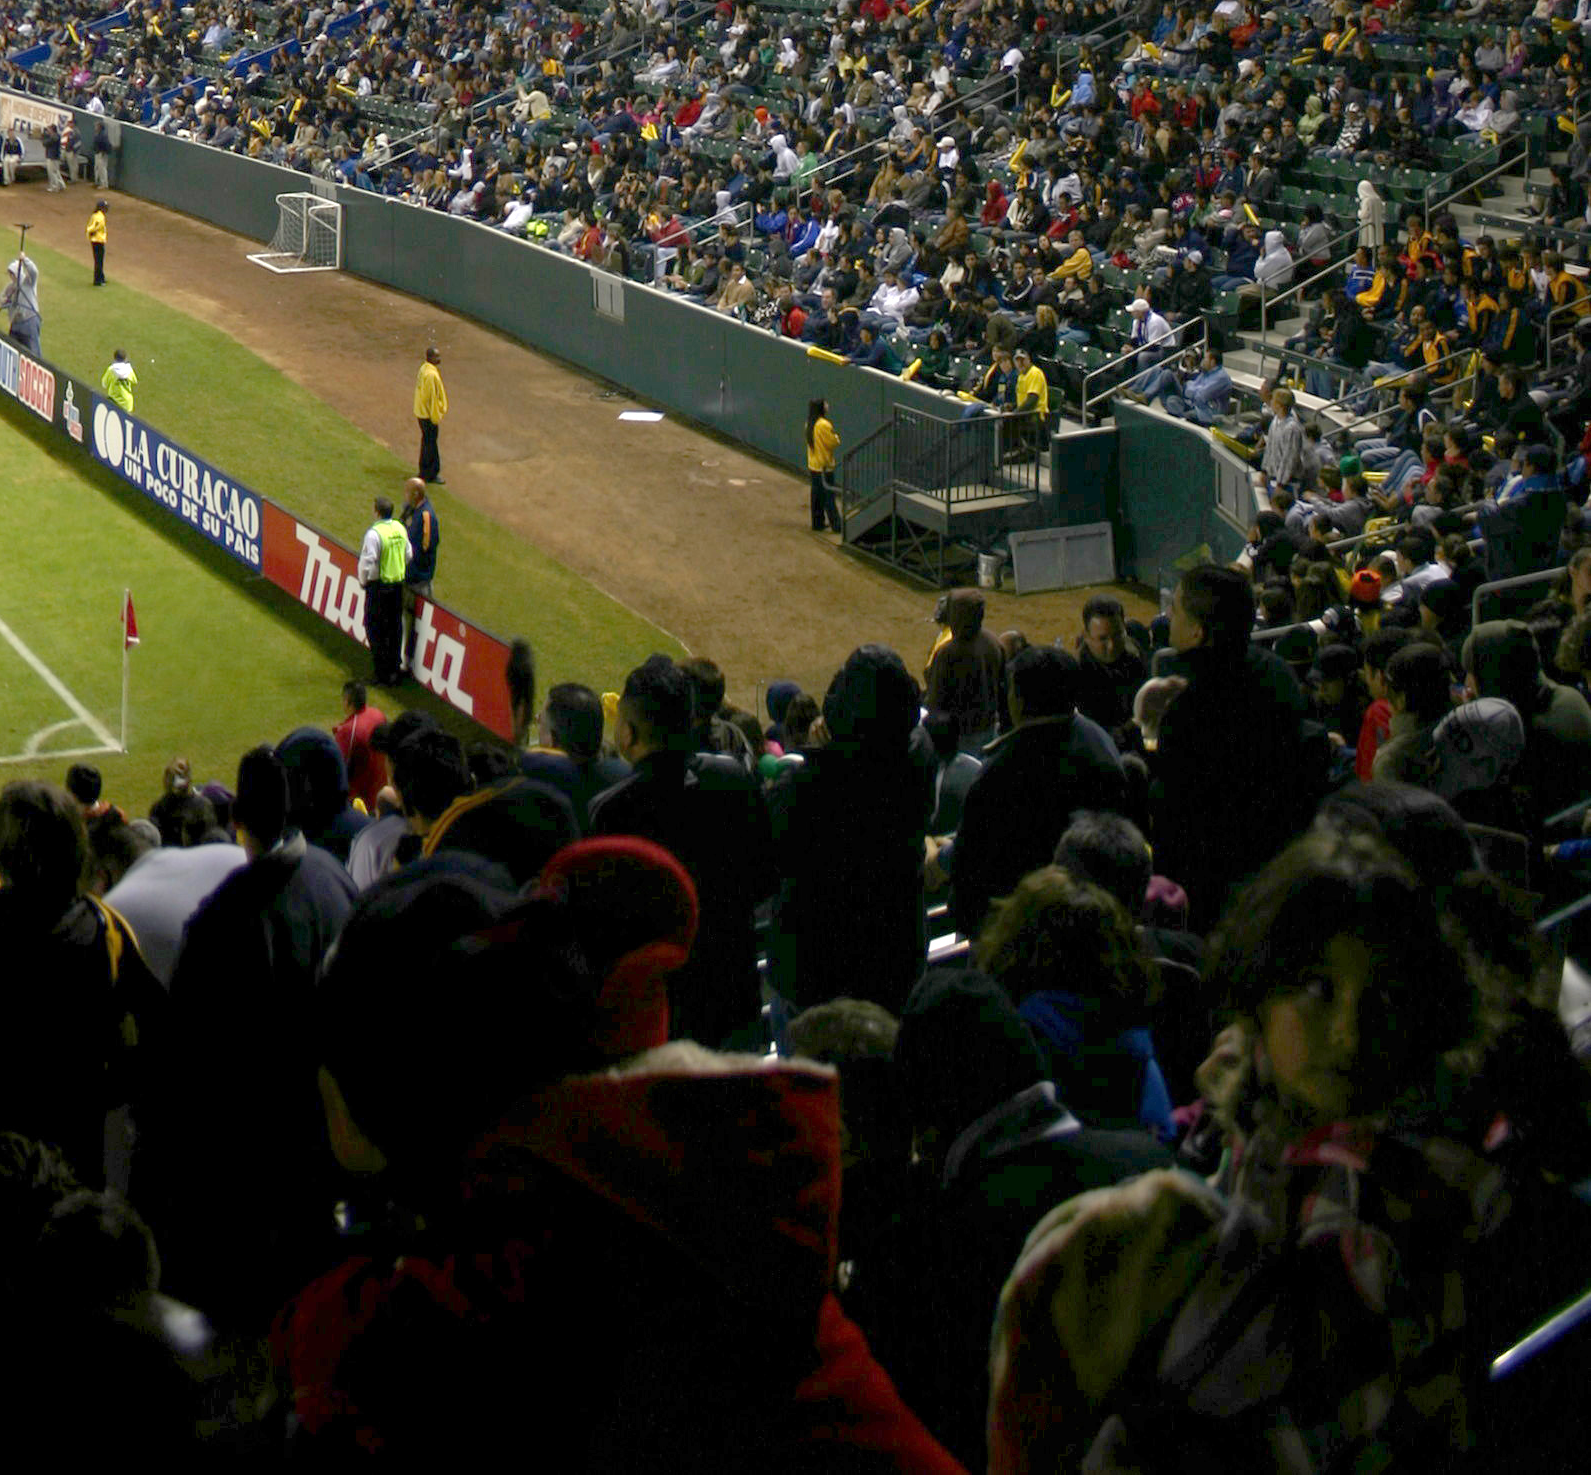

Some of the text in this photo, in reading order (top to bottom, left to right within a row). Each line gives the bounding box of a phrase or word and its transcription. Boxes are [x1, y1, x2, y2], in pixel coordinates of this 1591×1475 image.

[18, 353, 56, 423] SOCCER
[124, 456, 260, 566] UN POCO DE SU PAIS
[125, 419, 152, 471] LA
[157, 442, 260, 540] CURACAO
